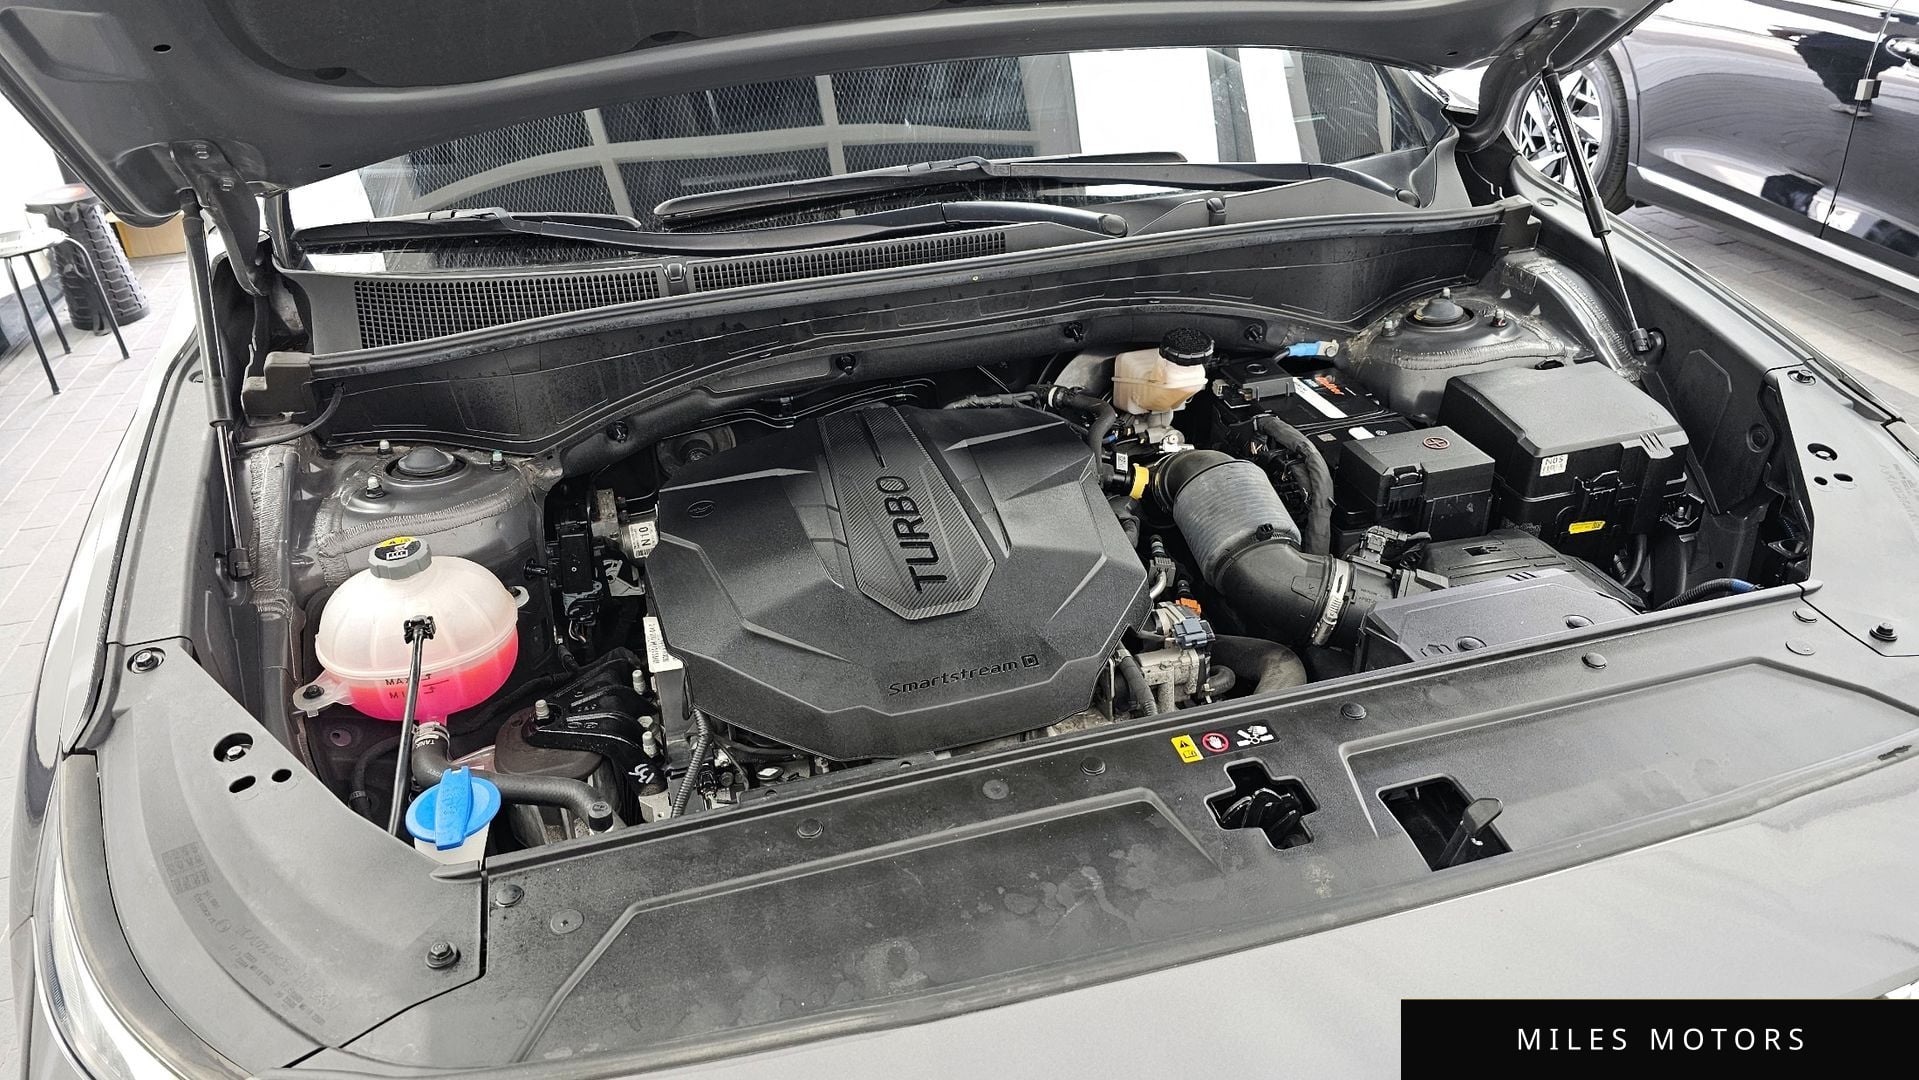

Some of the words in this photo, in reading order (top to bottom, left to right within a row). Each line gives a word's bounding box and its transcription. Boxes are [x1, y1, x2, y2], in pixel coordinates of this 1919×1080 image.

[638, 526, 652, 547] N10
[876, 475, 948, 593] TURBO
[888, 660, 1018, 696] Smartstream
